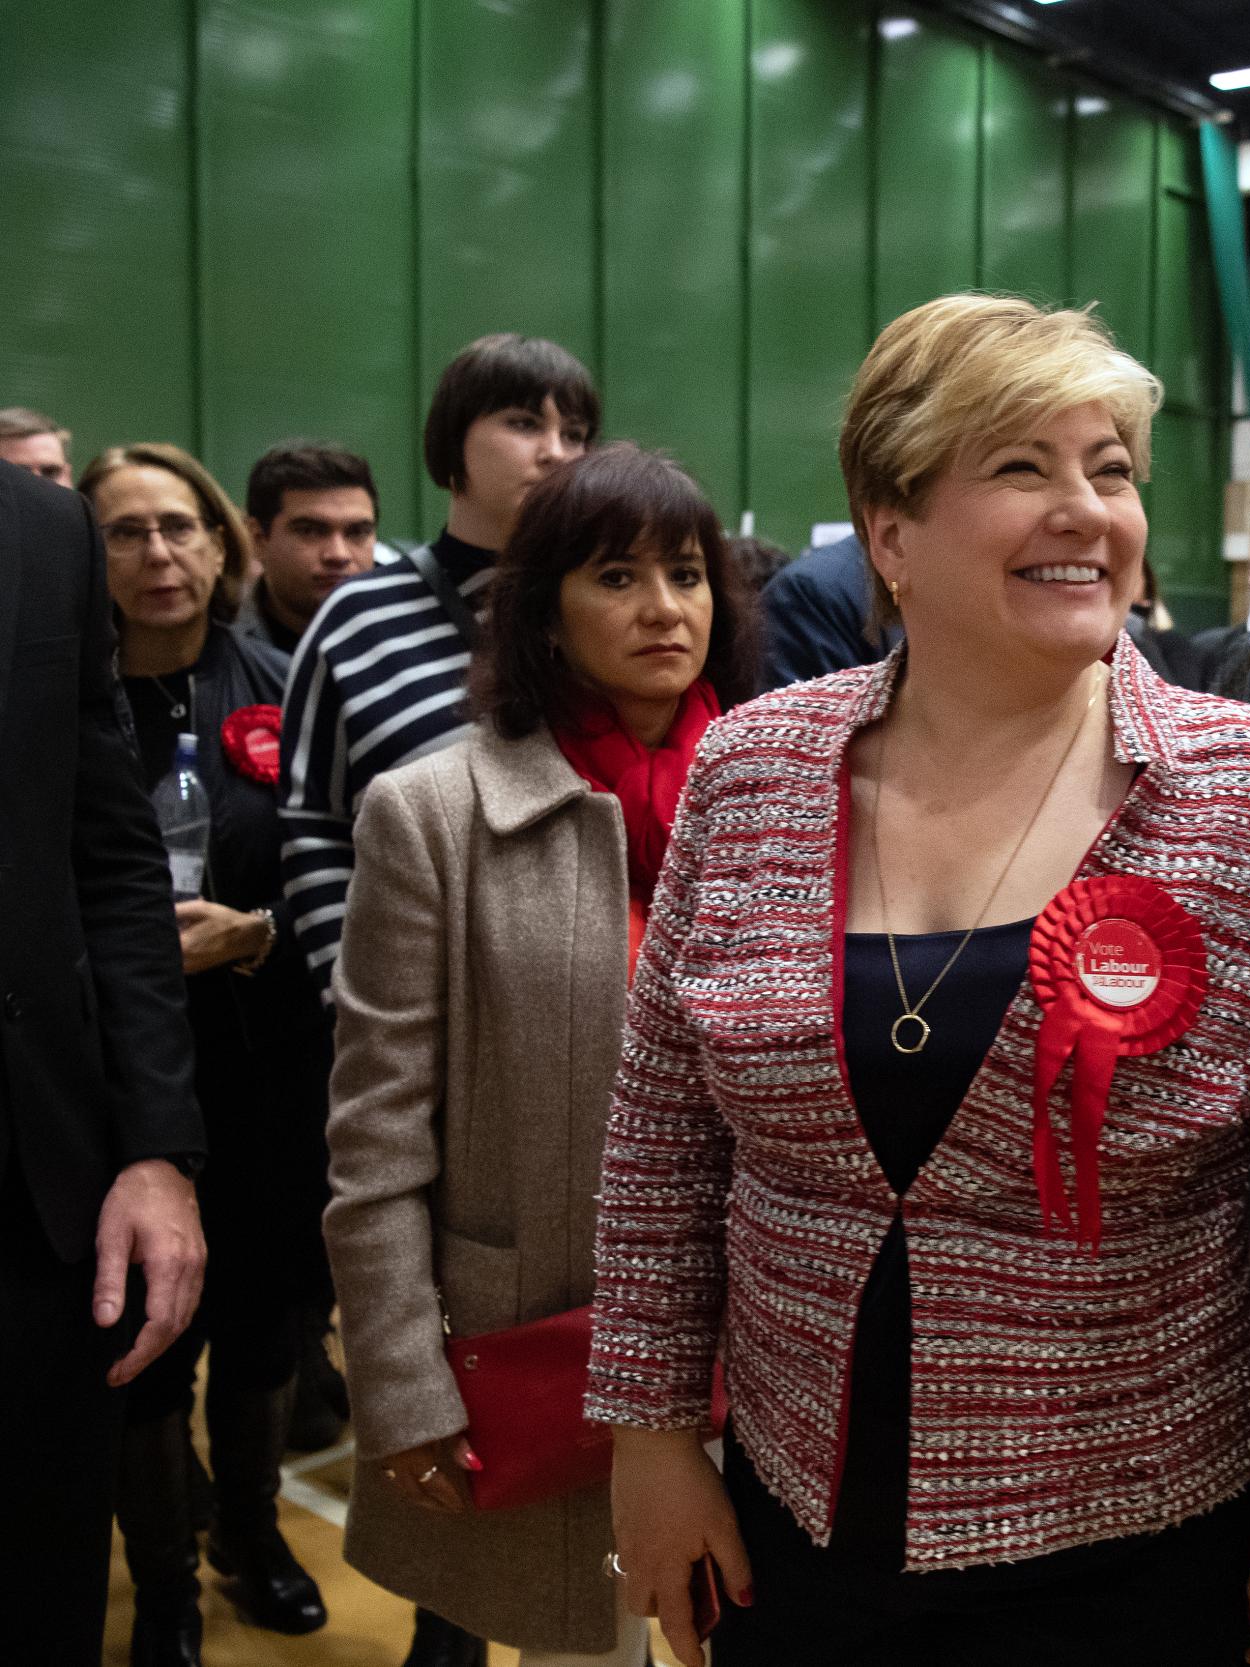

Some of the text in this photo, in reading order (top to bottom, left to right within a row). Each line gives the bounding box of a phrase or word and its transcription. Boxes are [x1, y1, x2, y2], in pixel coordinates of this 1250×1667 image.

[1089, 942, 1124, 956] Vote
[1091, 958, 1149, 973] Labour
[1104, 977, 1146, 988] Labour
